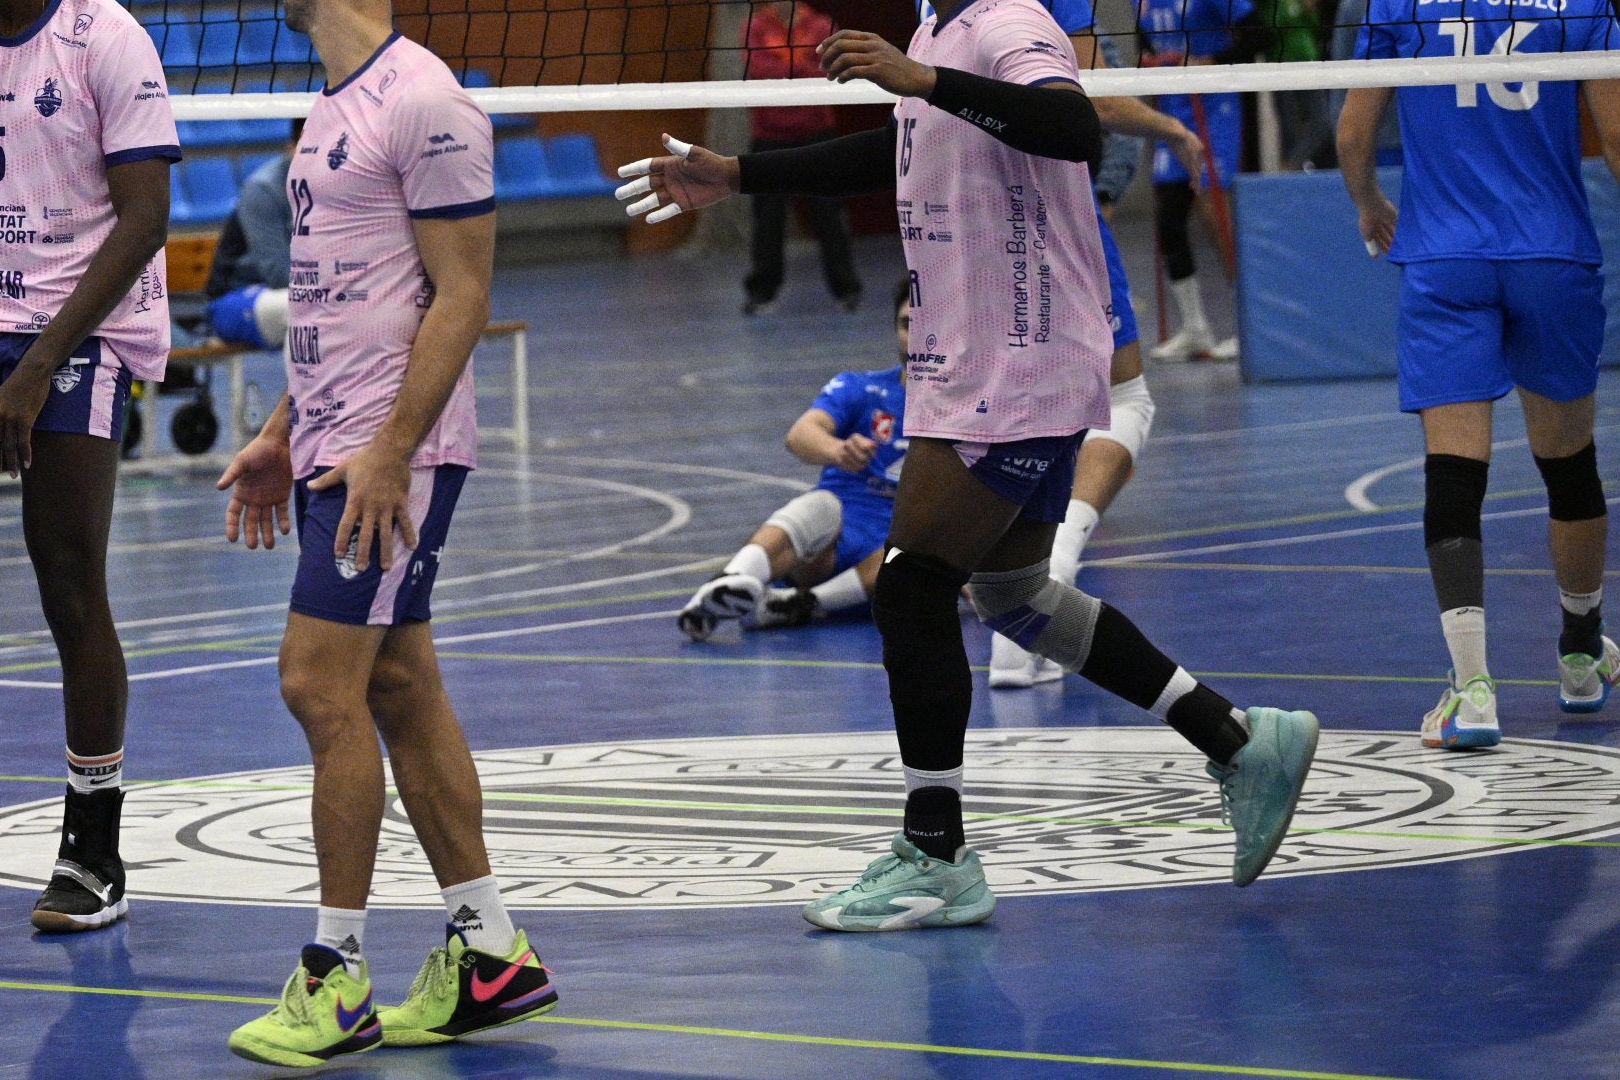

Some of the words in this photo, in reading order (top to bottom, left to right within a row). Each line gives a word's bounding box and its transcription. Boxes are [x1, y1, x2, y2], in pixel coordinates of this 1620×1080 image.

[899, 118, 917, 177] 15
[958, 107, 1008, 134] ALLSIX
[291, 178, 314, 236] 12
[1006, 185, 1027, 254] Barberá
[1008, 261, 1029, 348] Hermanos
[1034, 264, 1052, 343] Restaurante
